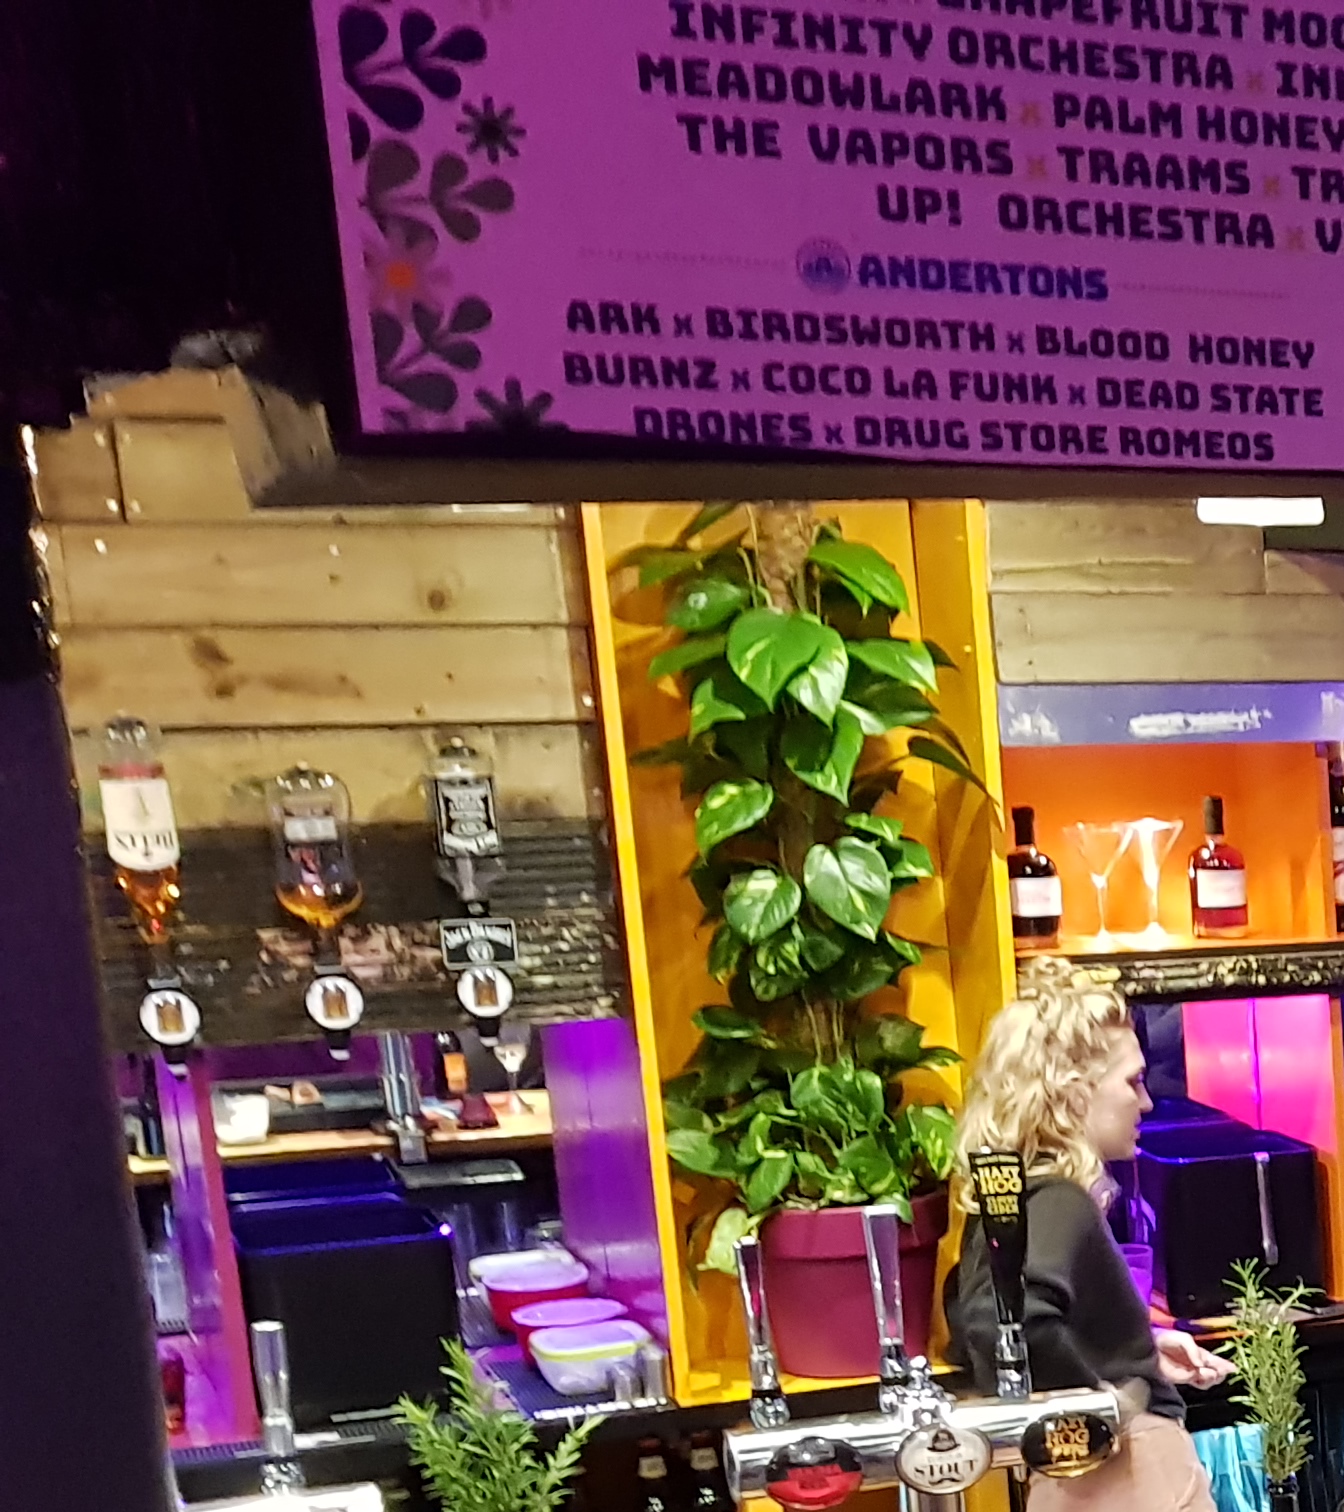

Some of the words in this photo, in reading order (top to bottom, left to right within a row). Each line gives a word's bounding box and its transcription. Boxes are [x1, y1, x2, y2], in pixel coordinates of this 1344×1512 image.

[669, 0, 932, 61] INFINITY
[947, 26, 1234, 92] ORCHESTRA
[637, 53, 1007, 121] MEADOWLARK
[1053, 89, 1184, 138] PALM
[678, 112, 781, 161] THE
[808, 122, 1014, 178] VAPORS
[1056, 145, 1251, 197] TRAAMS
[876, 183, 965, 230] UP!
[996, 195, 1275, 251] ORCHESTRA
[857, 253, 1109, 302] ANDERTONS
[566, 301, 662, 336] ARK
[704, 307, 996, 353] BIRDSWORTH
[1035, 325, 1170, 363] BLOOD
[1187, 332, 1316, 370] HONEY
[761, 362, 872, 397] COCO
[882, 365, 939, 402] LA
[949, 371, 1057, 407] FUNK
[1094, 378, 1200, 414] DEAD
[1209, 382, 1324, 418] STATE
[633, 404, 814, 447] DRONES
[853, 414, 970, 451] DRUG
[981, 420, 1110, 457] STORE
[1118, 425, 1275, 463] ROMEOS
[980, 1178, 1023, 1194] HOG
[914, 1459, 978, 1482] STOUT
